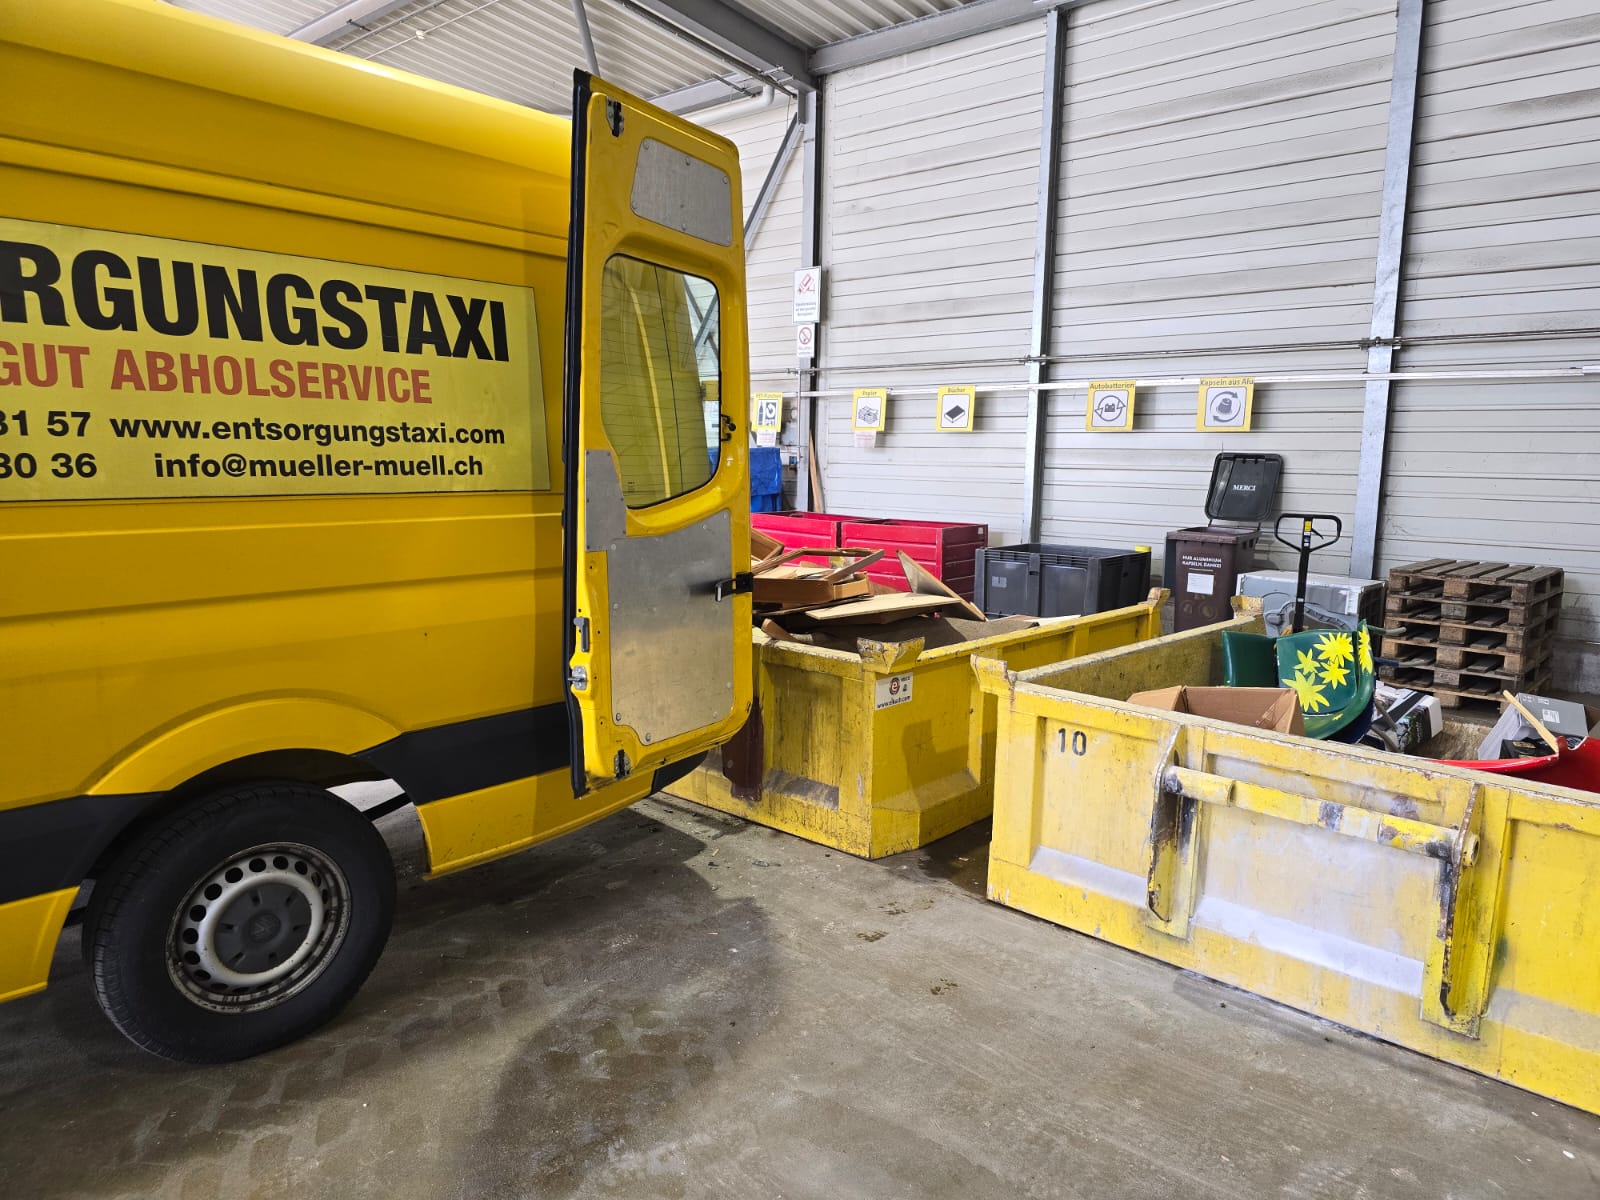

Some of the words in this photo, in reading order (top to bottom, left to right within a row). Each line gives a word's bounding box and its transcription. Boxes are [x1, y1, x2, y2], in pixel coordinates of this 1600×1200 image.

[0, 240, 510, 362] RGUNGSTAXI
[0, 341, 90, 389] GUT
[111, 349, 433, 404] ABHOLSERVICE
[47, 410, 91, 437] 57
[110, 417, 505, 447] www.entsorgungstaxi.com
[51, 452, 98, 479] 36
[154, 452, 483, 478] info@mueller-muell.ch
[1232, 484, 1256, 492] MERCI
[1058, 727, 1088, 757] 10
